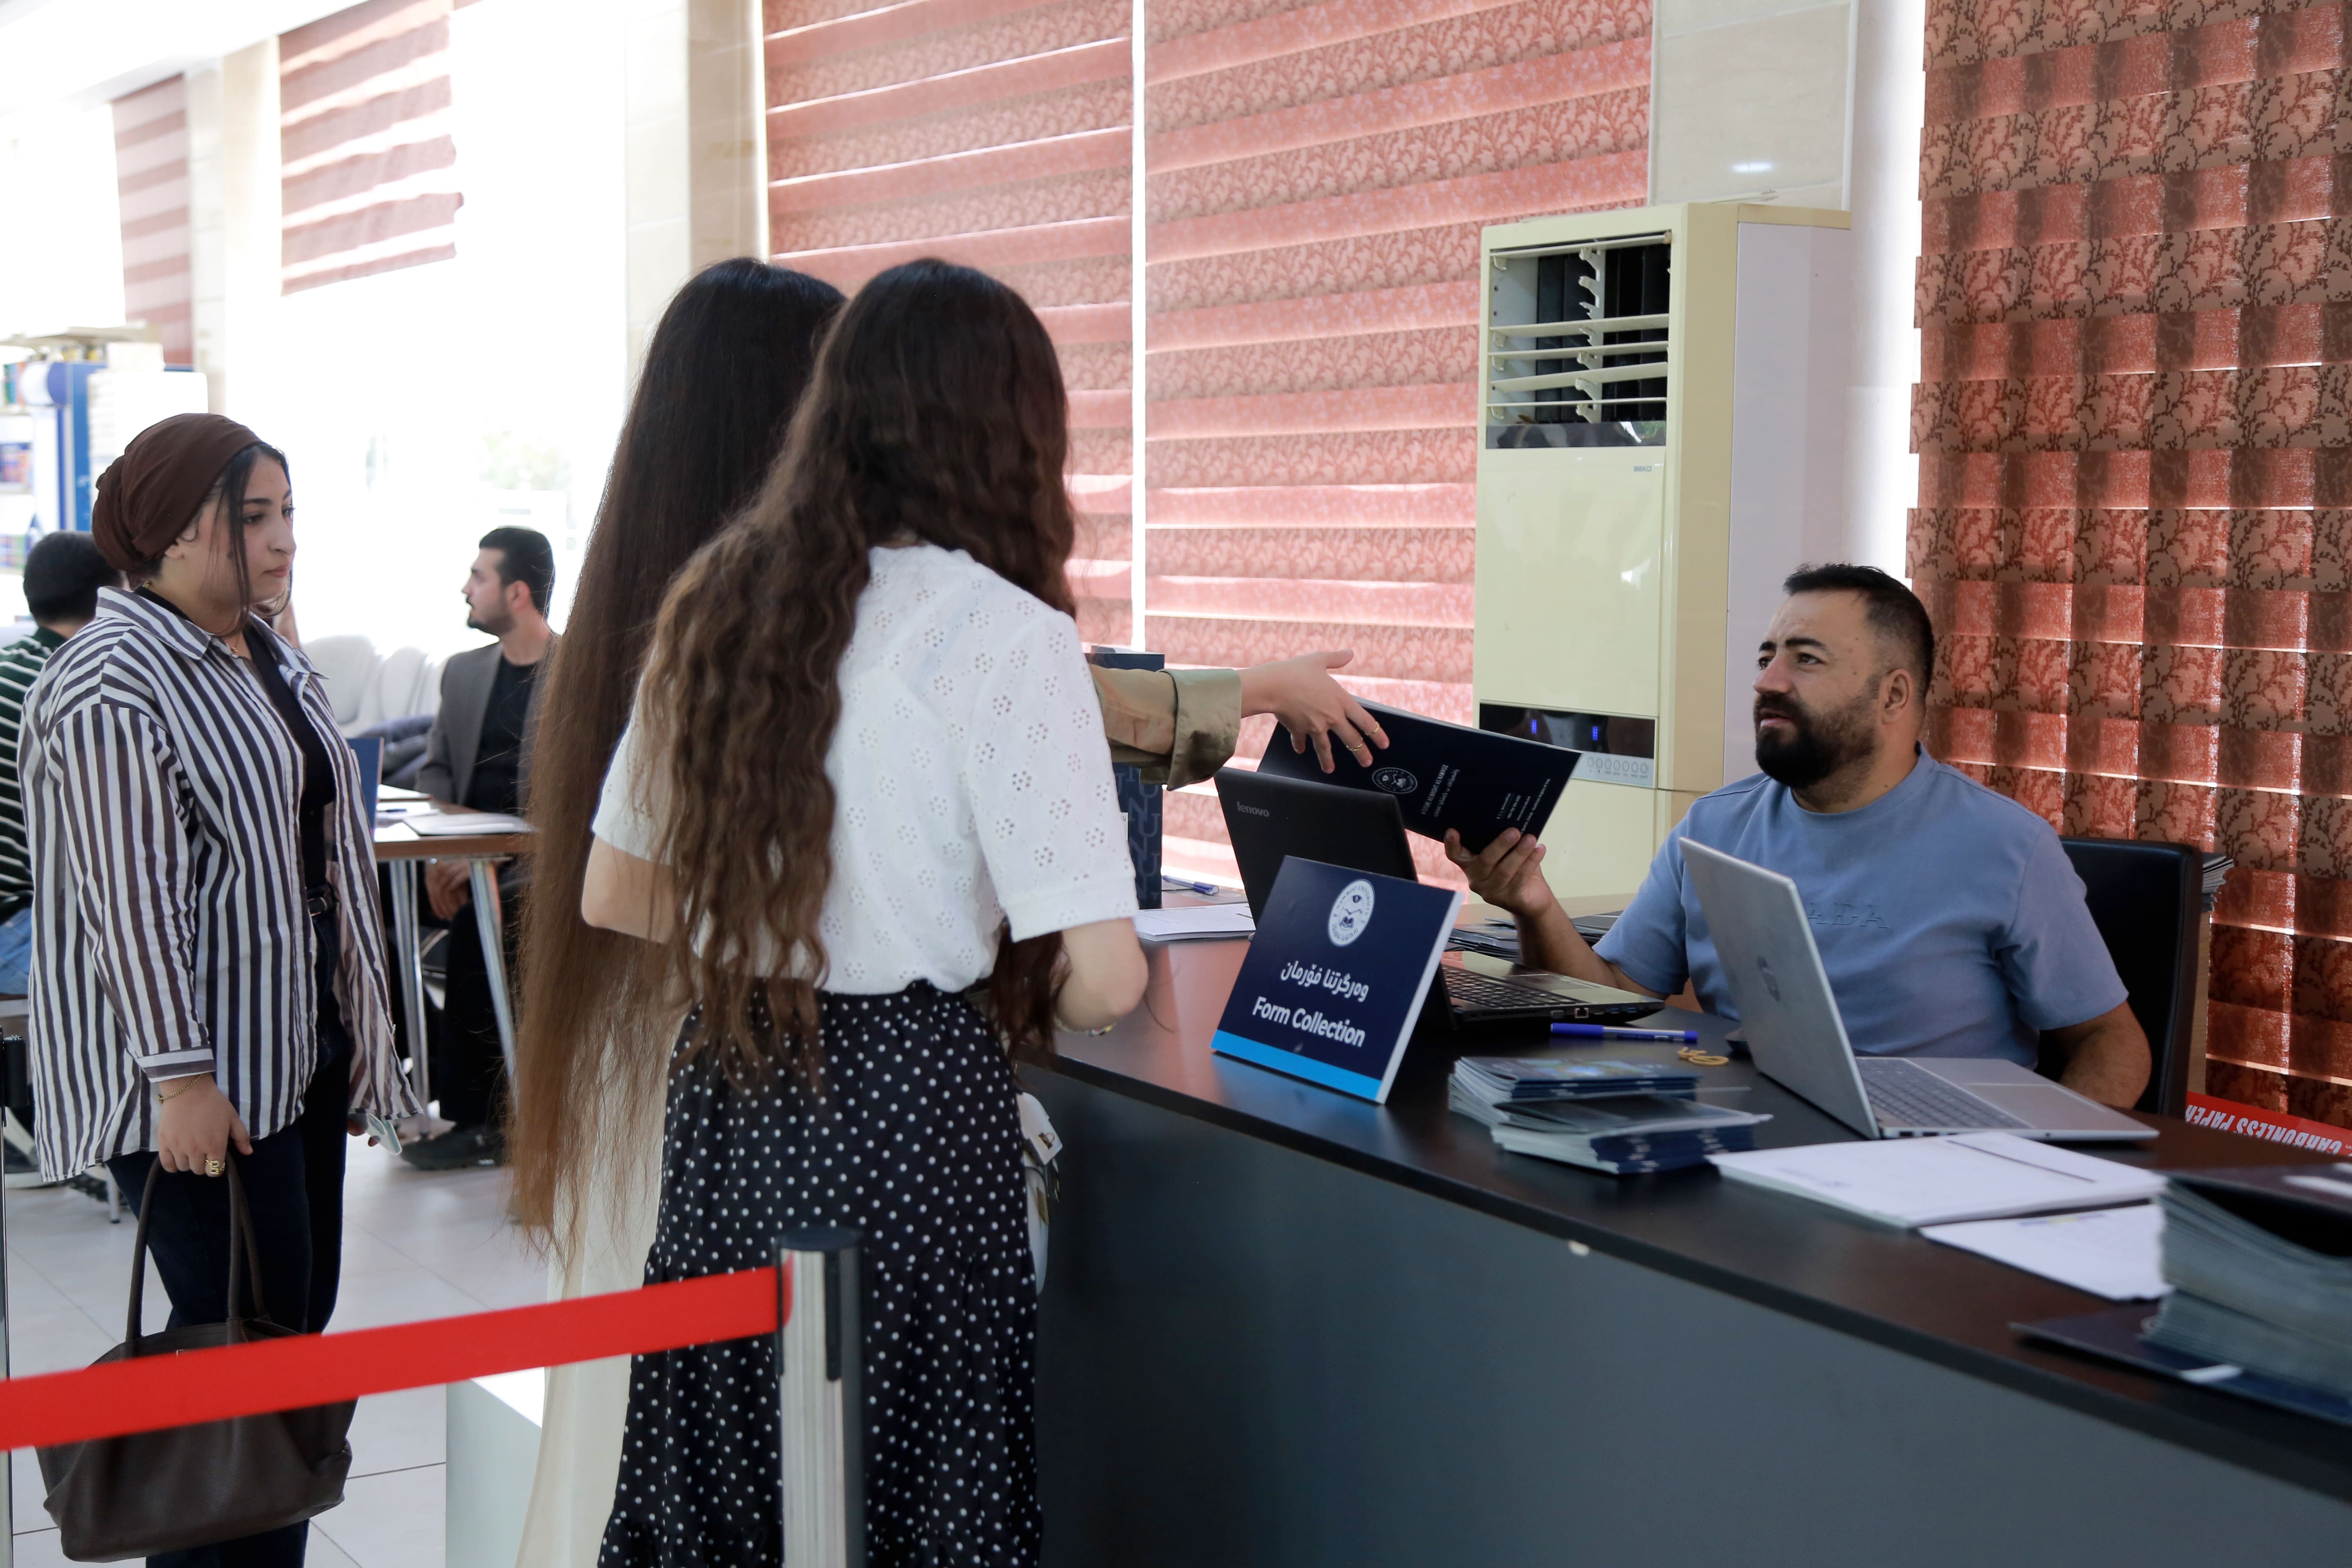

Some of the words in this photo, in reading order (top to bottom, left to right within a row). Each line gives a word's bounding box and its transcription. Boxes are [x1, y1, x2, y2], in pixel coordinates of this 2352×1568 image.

[1237, 801, 1270, 817] lenovo
[1808, 902, 1889, 929] ADA
[1252, 996, 1291, 1025] Form
[1292, 1007, 1366, 1048] Collection
